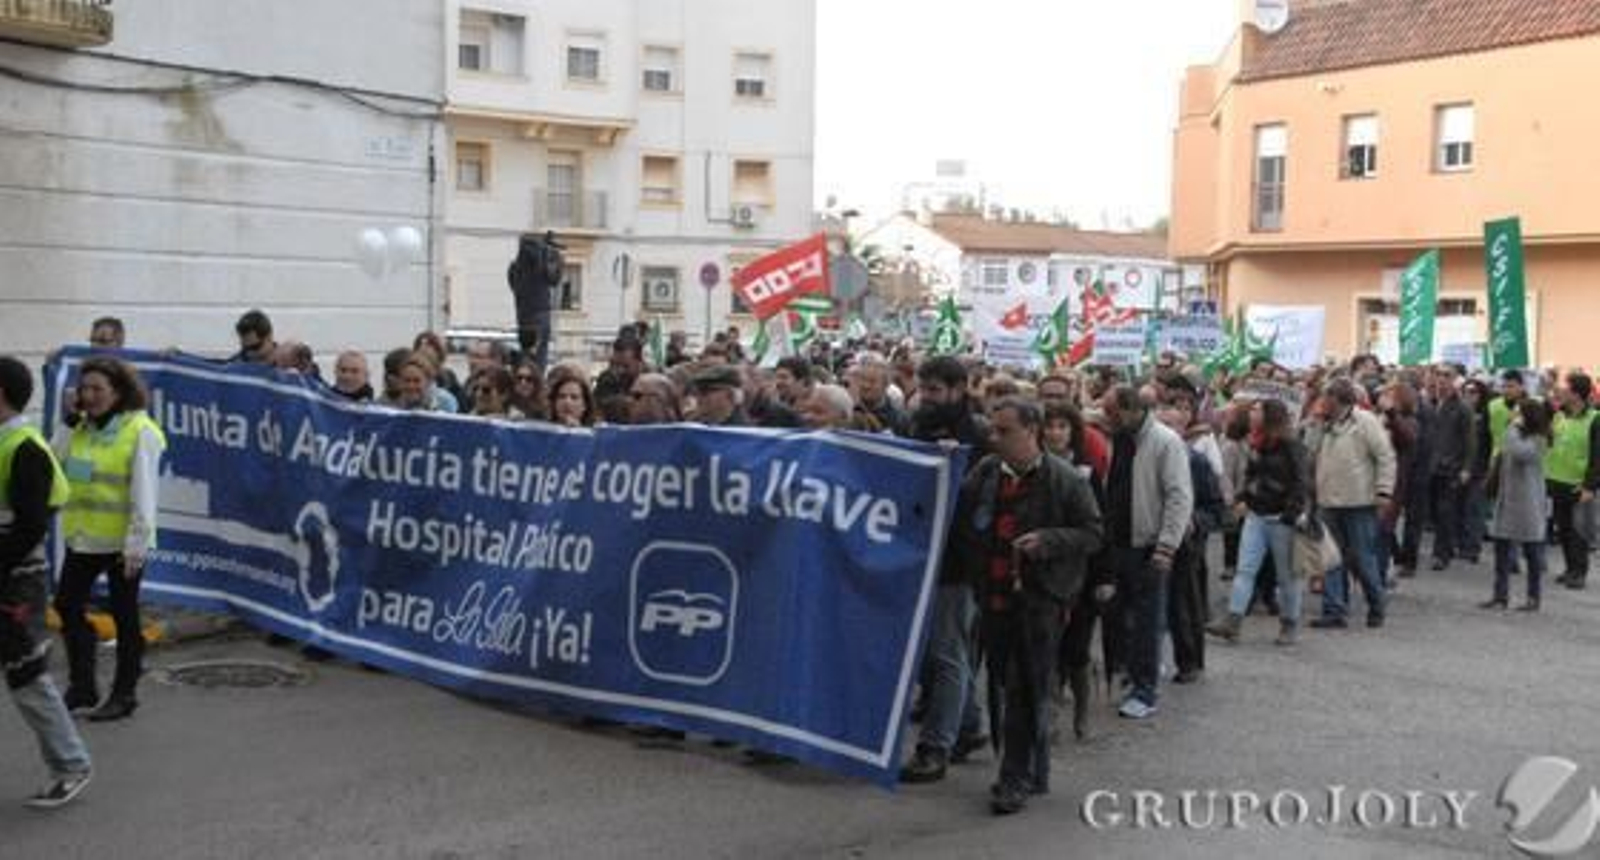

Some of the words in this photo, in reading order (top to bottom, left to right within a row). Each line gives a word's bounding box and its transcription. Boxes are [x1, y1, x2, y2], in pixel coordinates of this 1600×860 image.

[291, 416, 462, 491] Andalucía
[472, 446, 560, 504] tiene
[592, 459, 700, 520] coger
[709, 454, 751, 517] la
[762, 459, 899, 543] llave
[367, 499, 517, 569] Hospital
[357, 587, 435, 631] para
[530, 605, 593, 669] ¡Ya!
